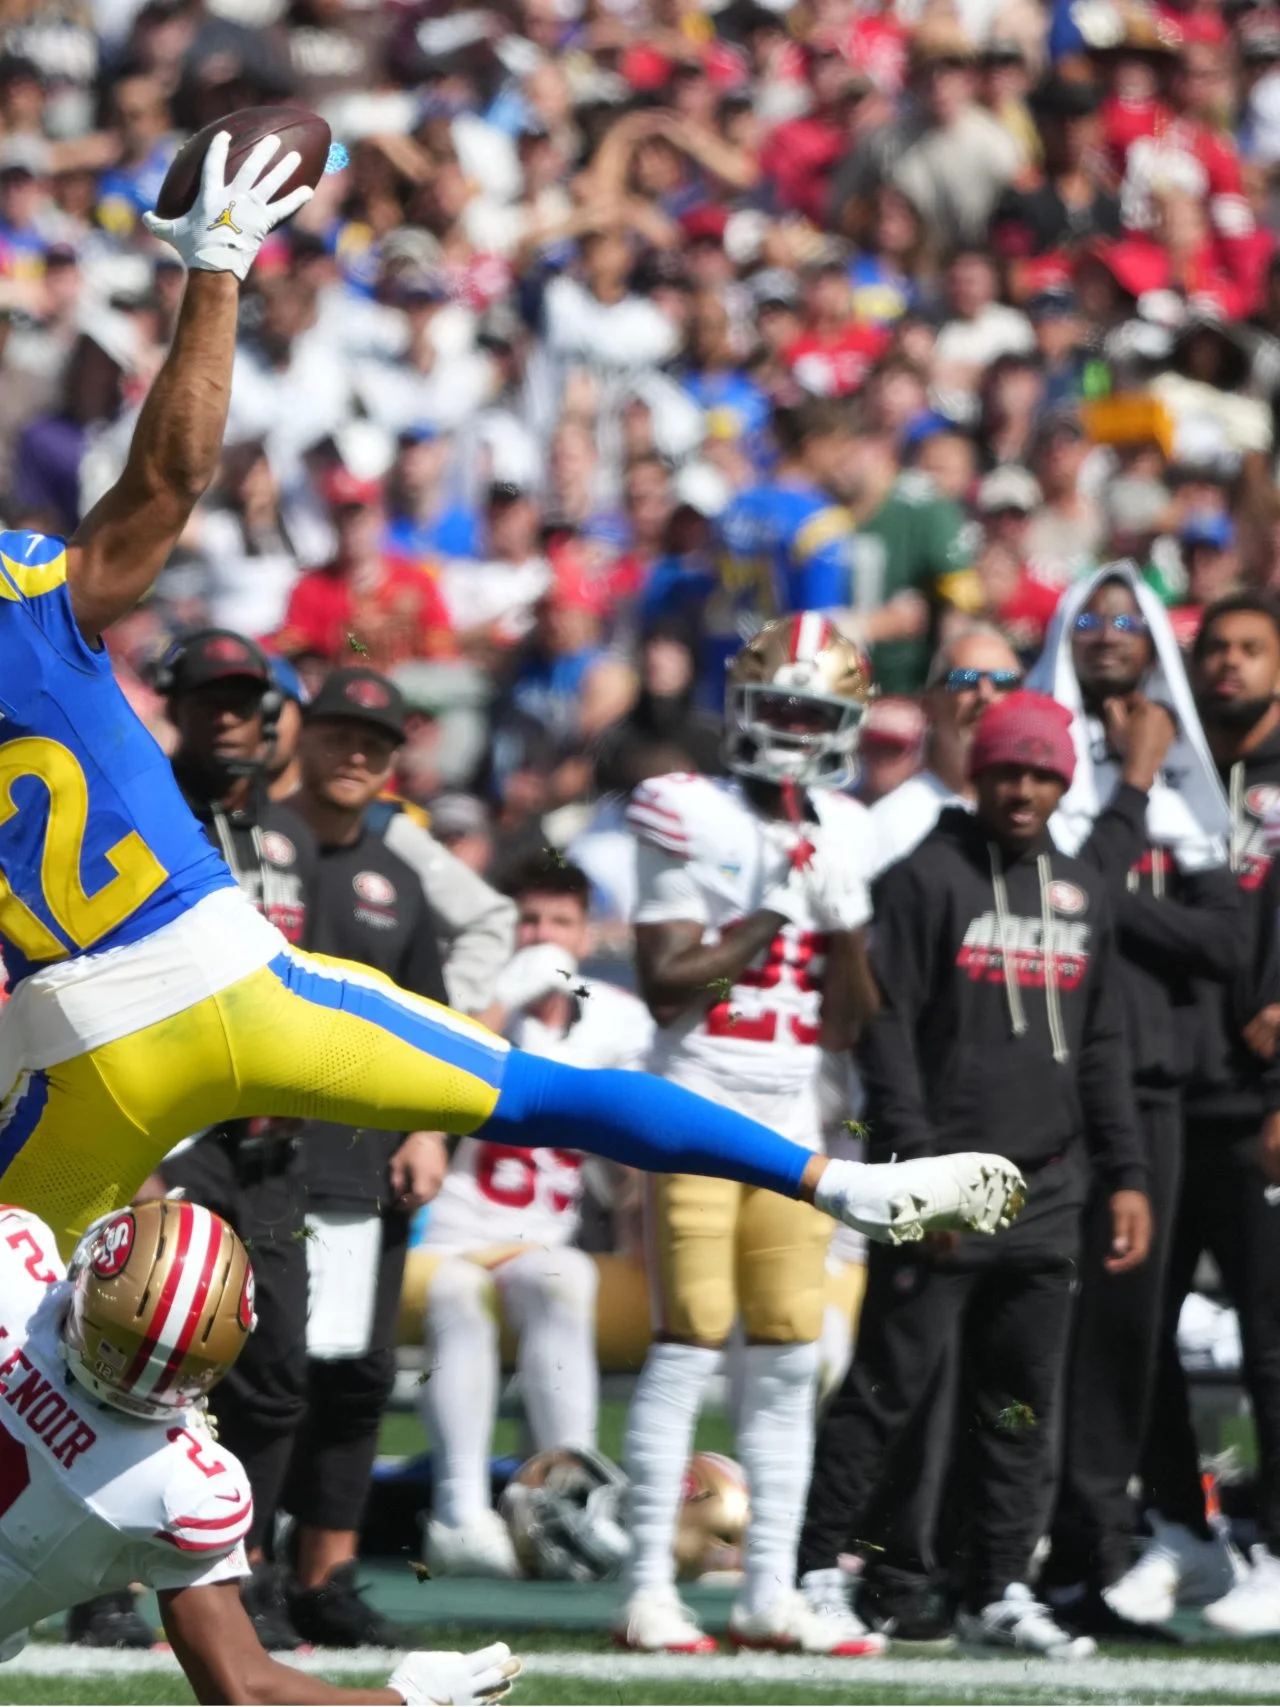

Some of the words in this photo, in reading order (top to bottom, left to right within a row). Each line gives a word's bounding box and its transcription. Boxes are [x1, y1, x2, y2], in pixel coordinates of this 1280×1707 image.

[5, 1228, 58, 1284] 2
[97, 1362, 113, 1377] 12
[166, 1426, 227, 1479] 2
